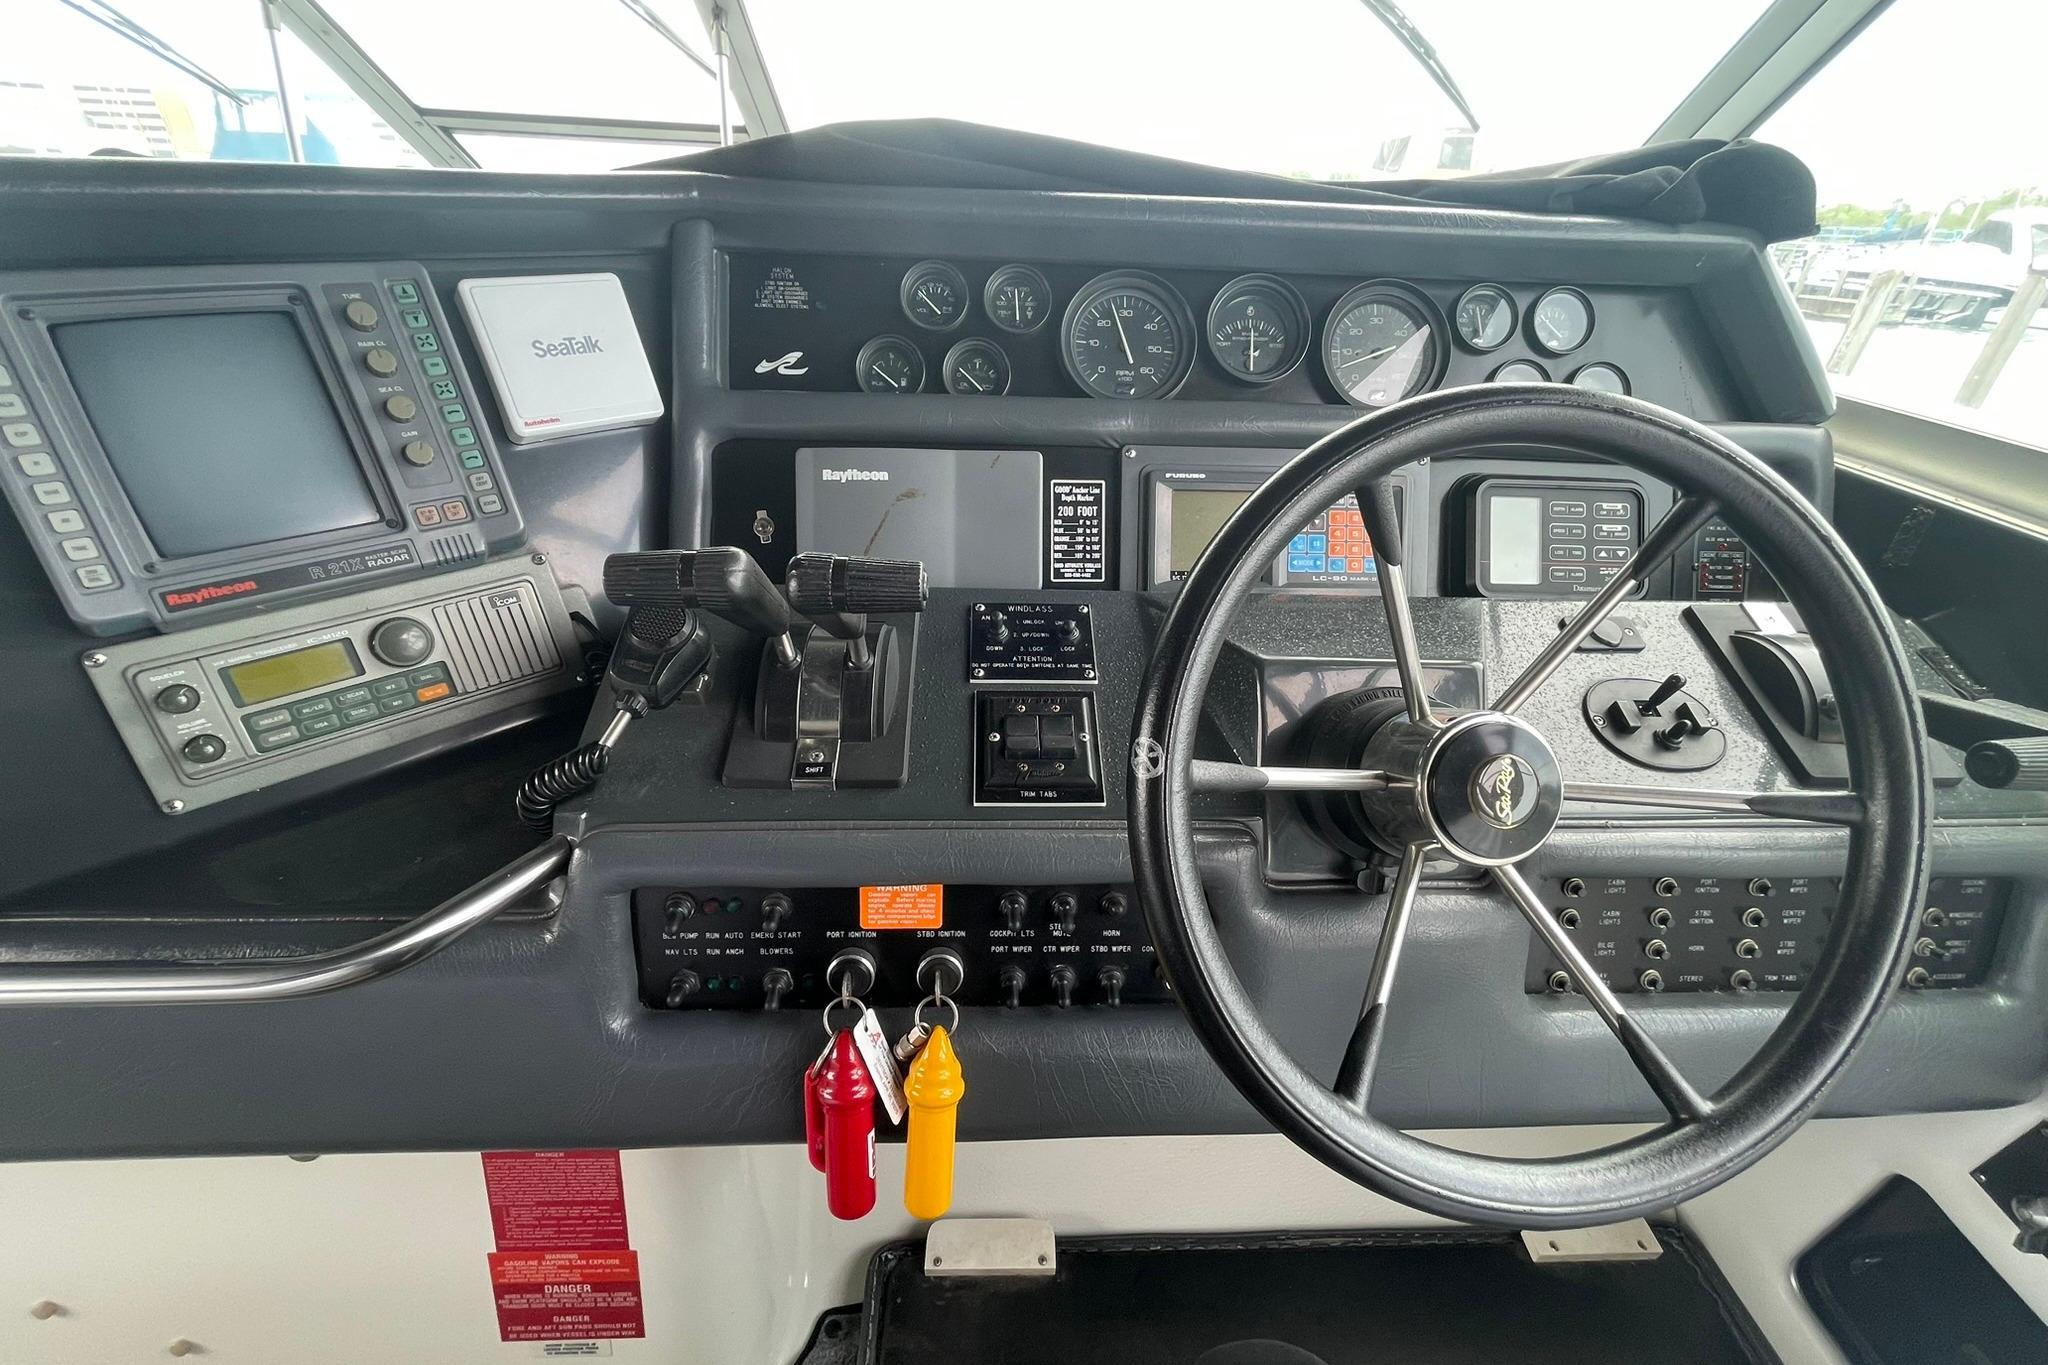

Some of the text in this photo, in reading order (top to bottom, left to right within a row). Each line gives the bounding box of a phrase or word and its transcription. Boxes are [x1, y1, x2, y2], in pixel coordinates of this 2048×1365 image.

[1369, 317, 1384, 325] 30
[1350, 328, 1363, 336] 20
[531, 336, 604, 358] SeaTalk
[524, 417, 561, 427] Autohelm
[822, 469, 889, 483] Raytheon
[1090, 486, 1100, 494] Line
[1062, 494, 1076, 502] Depth
[1058, 506, 1098, 516] 200 FOOT
[308, 553, 410, 580] R 21X RADAR
[166, 580, 258, 606] Raytheon
[150, 670, 185, 682] SQUELCH
[351, 707, 368, 716] DUAL
[805, 766, 824, 774] SHIFT
[1496, 762, 1515, 825] Sea Ray
[544, 1284, 591, 1293] DANGER
